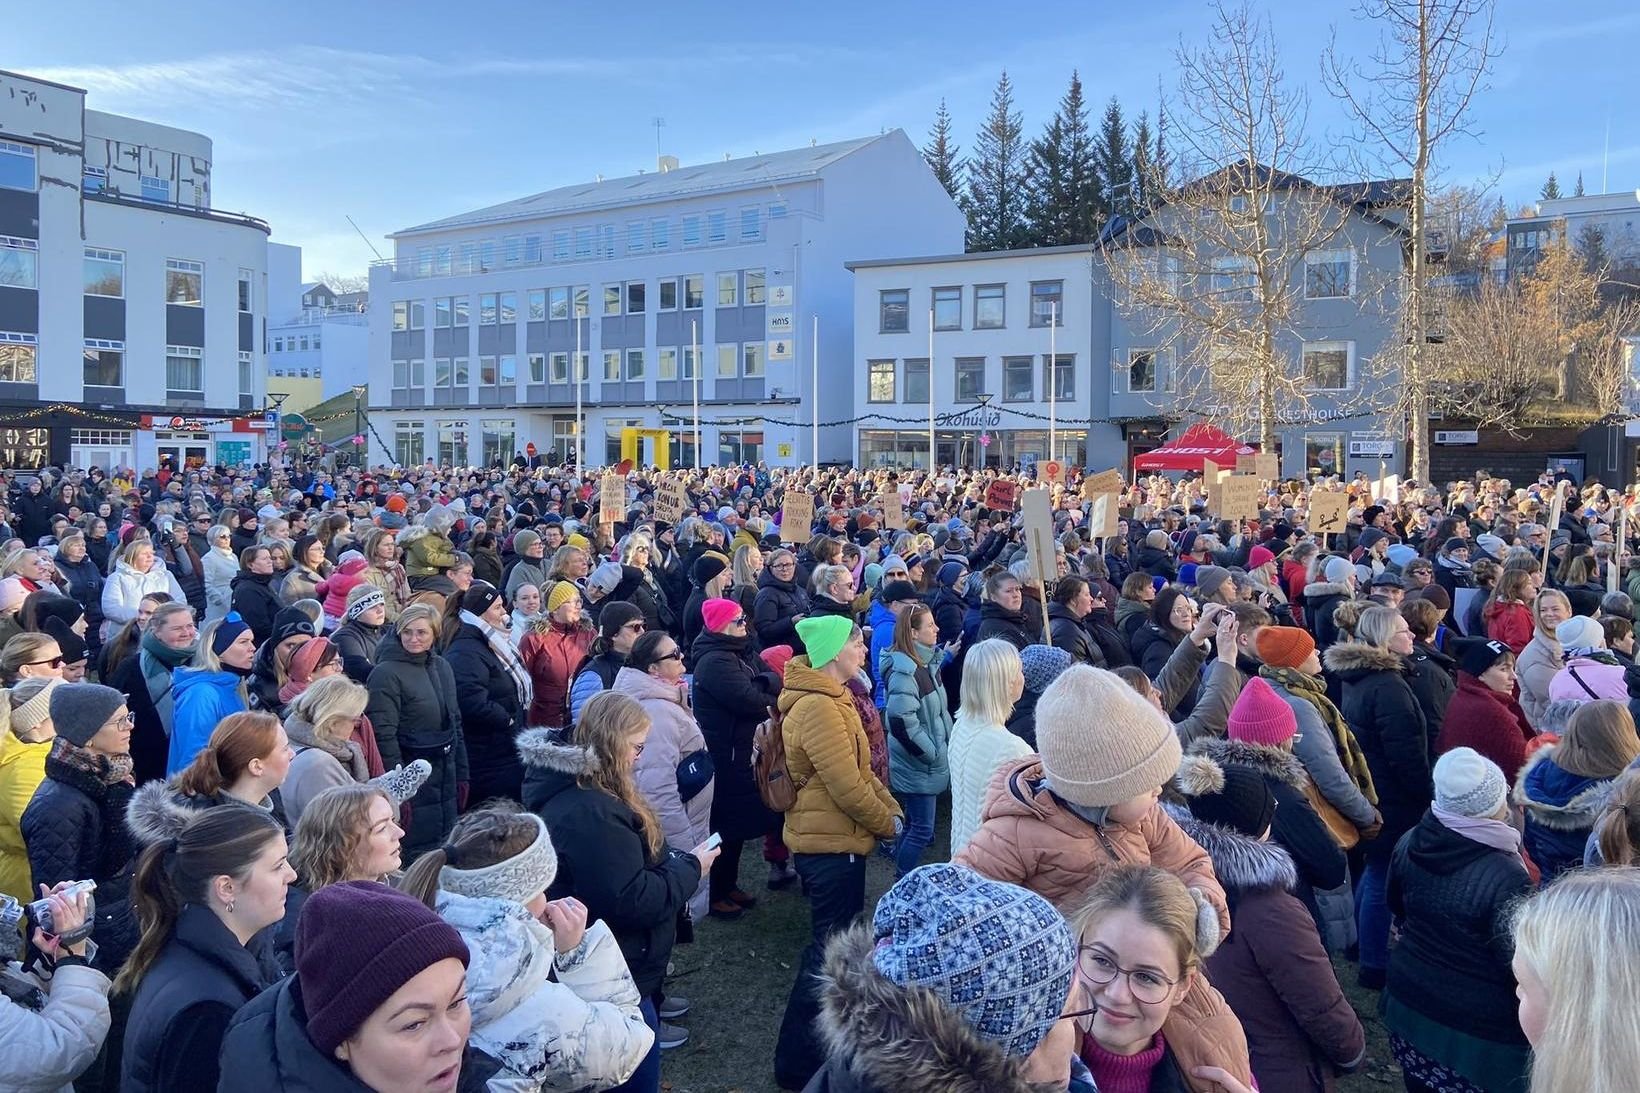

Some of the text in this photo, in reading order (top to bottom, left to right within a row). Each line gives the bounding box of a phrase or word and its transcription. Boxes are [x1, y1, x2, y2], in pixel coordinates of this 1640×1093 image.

[1266, 409, 1353, 420] UESTHOUSE
[1148, 446, 1230, 455] GHOST
[658, 492, 679, 508] KONUR
